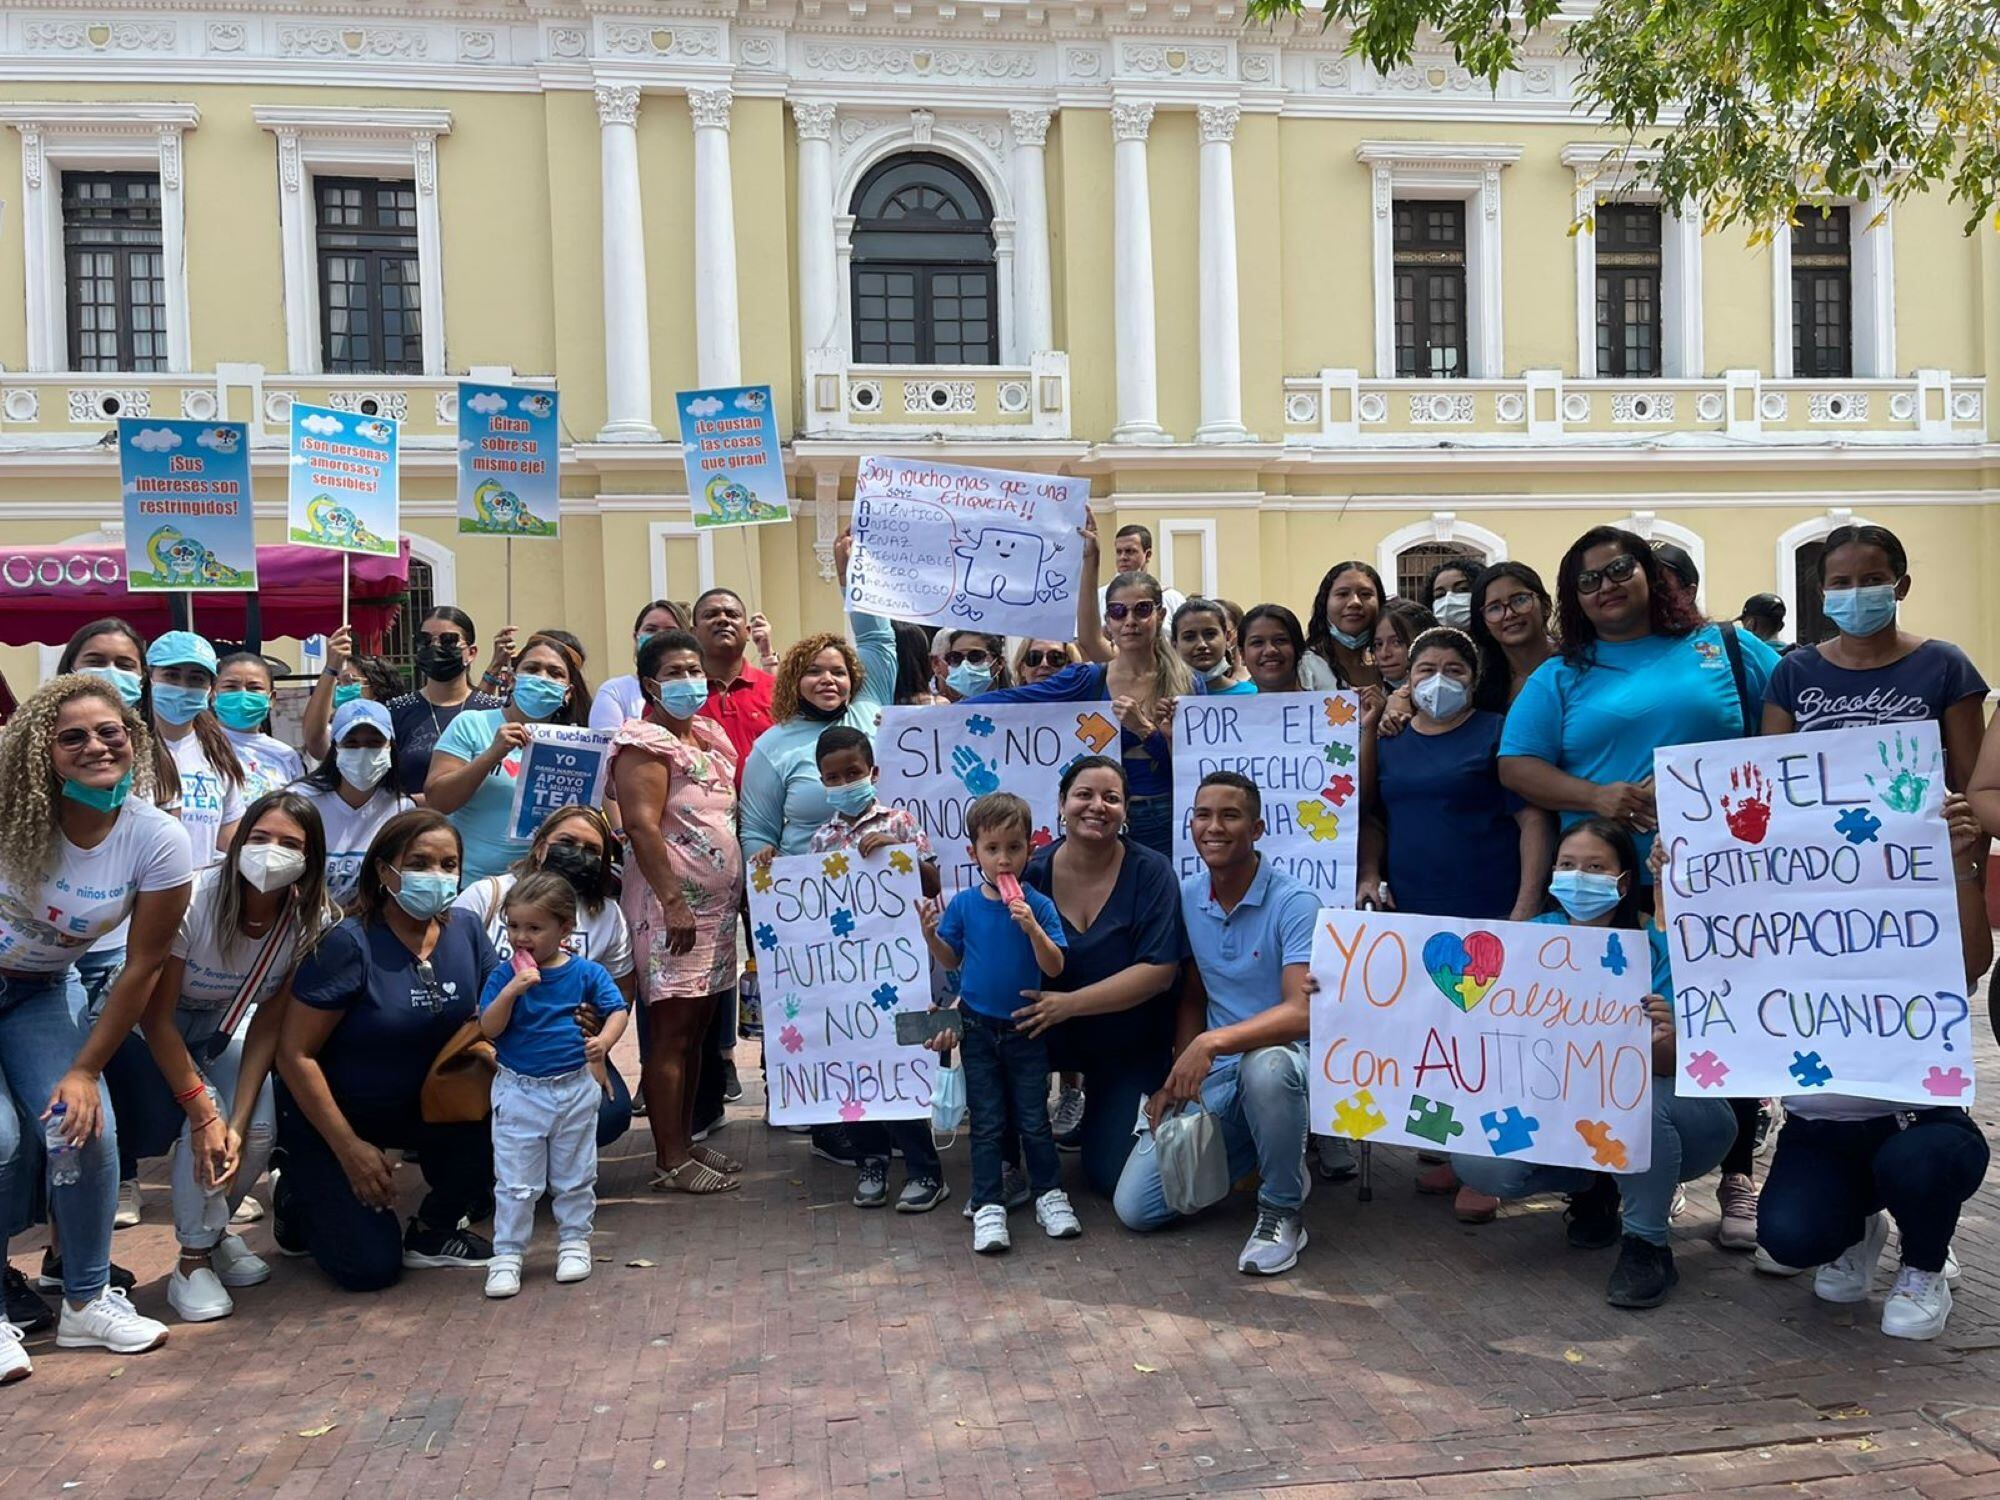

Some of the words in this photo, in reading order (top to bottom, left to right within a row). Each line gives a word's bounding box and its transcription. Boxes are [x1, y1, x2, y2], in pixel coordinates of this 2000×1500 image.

[489, 416, 530, 433] ¡Giran
[716, 415, 762, 434] gustan
[301, 437, 330, 453] ¡Son
[331, 443, 389, 463] personas
[481, 437, 519, 452] sobre
[520, 440, 537, 454] su
[700, 437, 722, 452] las
[723, 435, 762, 449] cosas
[170, 455, 203, 474] ¡Sus
[309, 457, 372, 477] amorosas
[372, 467, 380, 479] y
[473, 456, 517, 472] mismo
[519, 458, 545, 474] eje!
[701, 457, 723, 471] que
[723, 451, 767, 470] giran!
[136, 476, 210, 493] intereses
[211, 479, 239, 494] son
[312, 472, 378, 494] sensibles!
[900, 468, 952, 488] mucho
[955, 475, 989, 492] mas
[1000, 478, 1030, 500] que
[1037, 483, 1068, 501] una
[139, 499, 239, 518] restringidos!
[1795, 686, 1930, 722] Brooklyn
[1184, 705, 1243, 746] POR
[1282, 704, 1326, 746] EL
[555, 753, 577, 767] YO
[897, 726, 942, 778] SI
[1005, 725, 1061, 767] NO
[534, 782, 547, 790] AL
[549, 784, 584, 794] MUNDO
[536, 772, 585, 787] APOYO
[1666, 758, 1713, 822] Y
[1777, 752, 1872, 807] EL
[533, 789, 579, 807] TEA
[1669, 836, 1861, 898] CERTIFICADO
[1883, 843, 1939, 882] DE
[56, 878, 70, 892] de
[76, 885, 106, 900] niños
[109, 886, 124, 898] con
[773, 868, 906, 923] SOMOS
[1674, 908, 1939, 963] DISCAPACIDAD
[773, 936, 920, 990] AUTISTAS
[1325, 922, 1408, 1008] YO
[1538, 935, 1582, 972] a
[1488, 982, 1646, 1028] alguien
[826, 1000, 879, 1046] NO
[1757, 989, 1969, 1053] CUANDO?
[1412, 1027, 1648, 1112] AUTISMO
[775, 1057, 933, 1109] INVISIBLES
